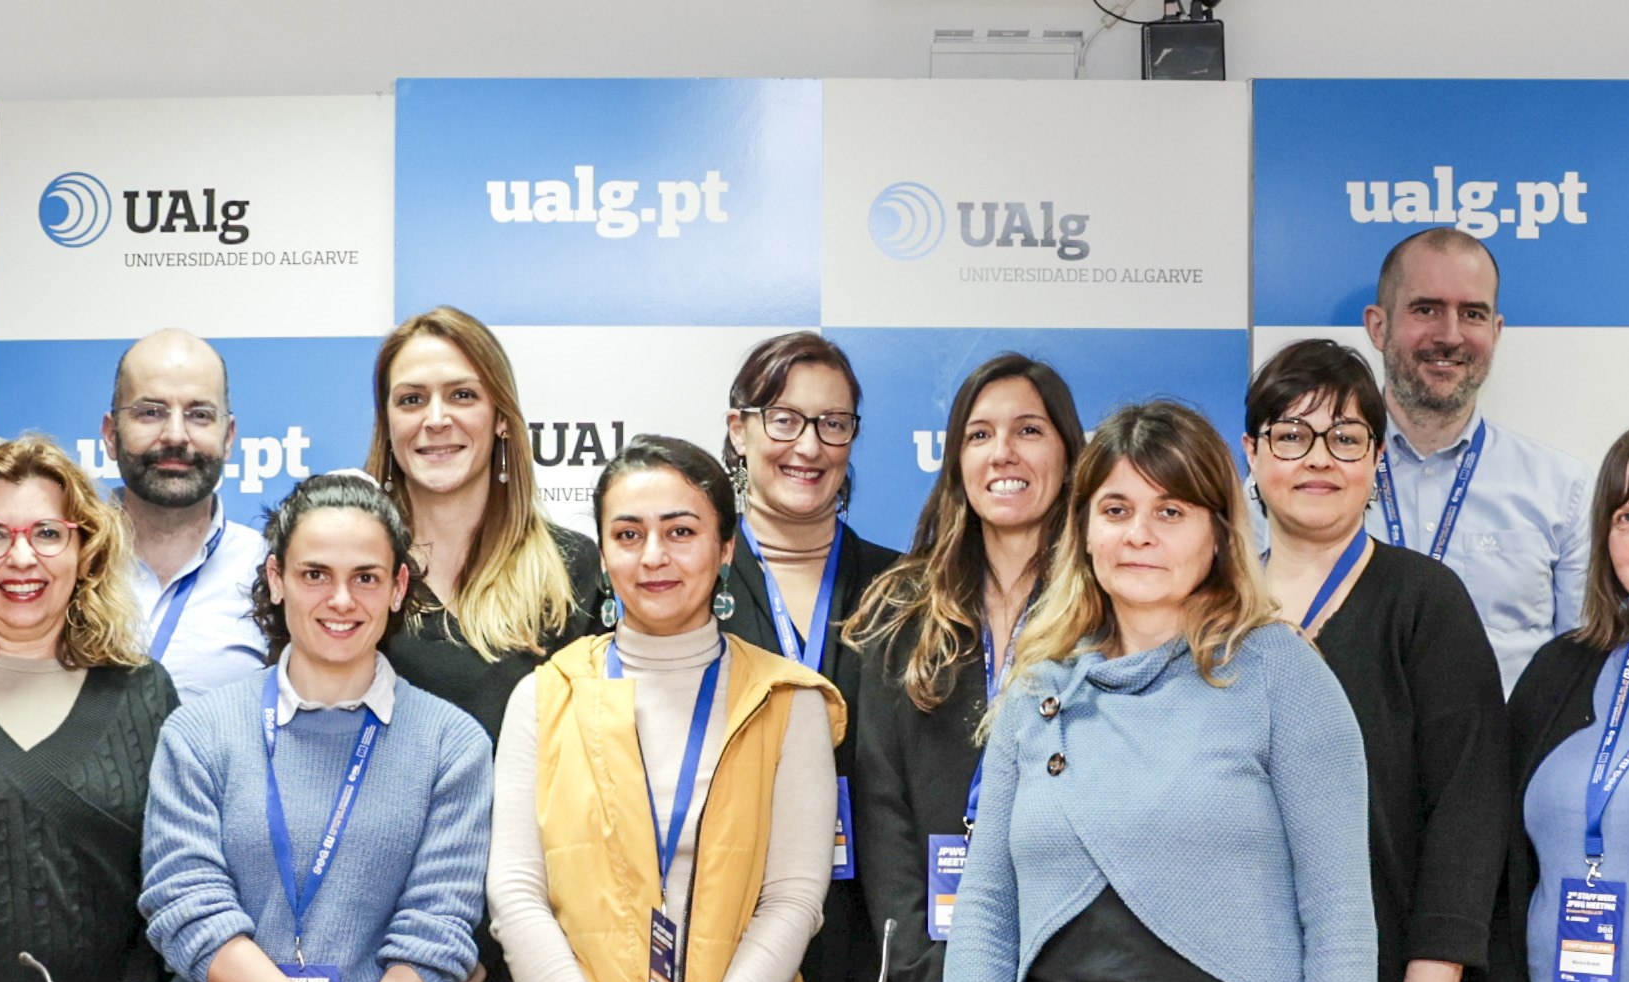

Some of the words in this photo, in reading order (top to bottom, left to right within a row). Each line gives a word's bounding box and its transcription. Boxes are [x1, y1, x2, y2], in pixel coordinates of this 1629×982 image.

[124, 189, 250, 244] UAlg
[487, 166, 728, 238] ualg.pt
[1346, 166, 1588, 239] ualg.pt
[958, 202, 1090, 261] UAlg
[124, 252, 248, 267] UNIVERSIDADE
[252, 252, 276, 265] DO
[279, 251, 359, 265] ALGARVE
[959, 268, 1088, 282] UNIVERSIDADE
[1092, 268, 1117, 282] DO
[1121, 268, 1203, 283] ALGARVE
[529, 421, 624, 467] UAl
[937, 857, 968, 867] MEET
